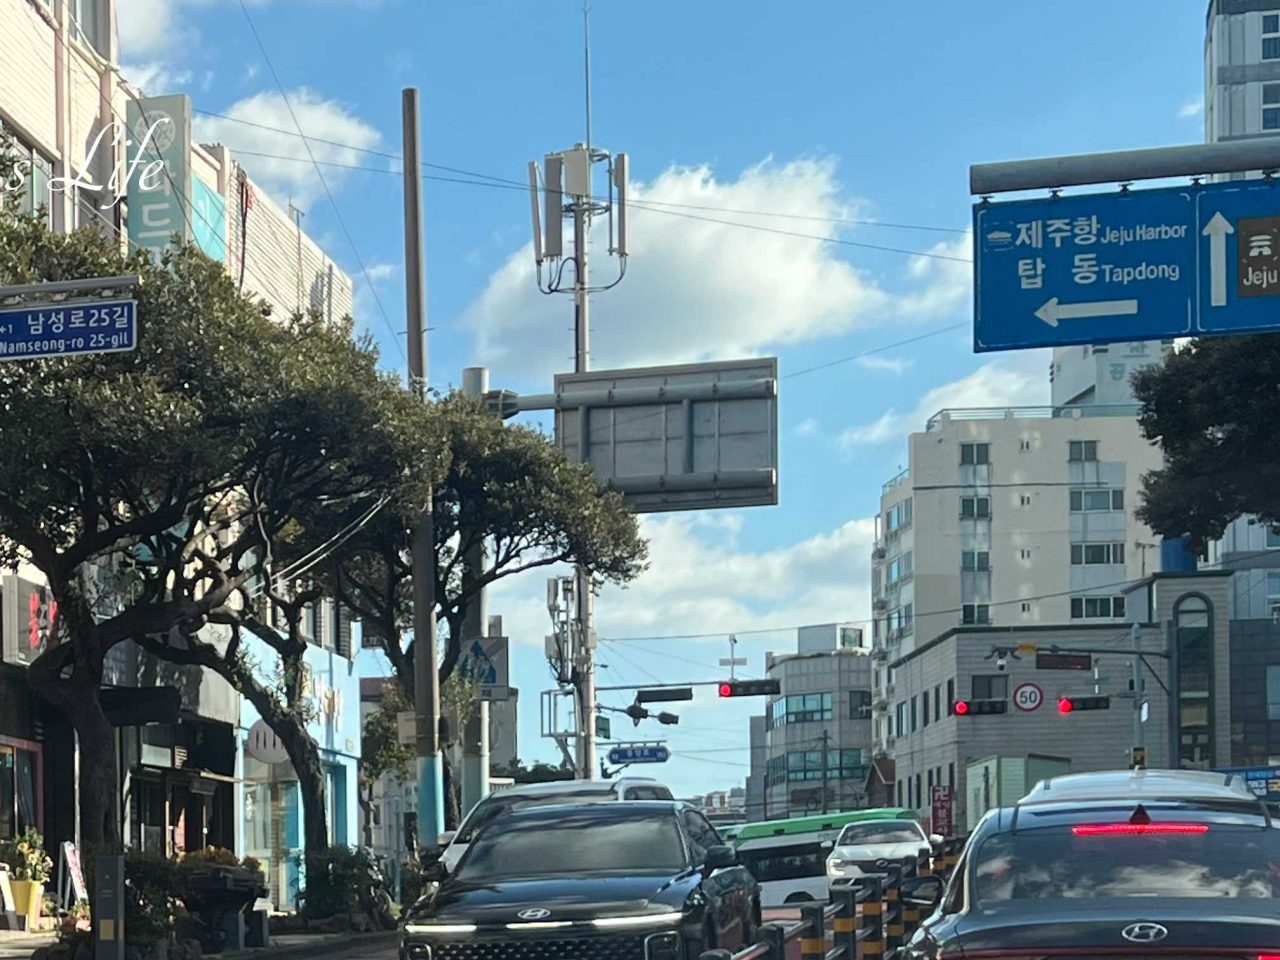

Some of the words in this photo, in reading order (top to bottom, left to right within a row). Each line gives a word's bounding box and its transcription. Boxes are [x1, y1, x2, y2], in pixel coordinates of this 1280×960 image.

[1015, 215, 1101, 248] 제주항
[1101, 226, 1134, 246] Jeju
[1136, 223, 1187, 241] Harbor
[1101, 262, 1180, 285] Tapdong
[1243, 266, 1278, 289] Jeju
[27, 306, 128, 335] 남성로25길
[0, 337, 84, 354] Namseong-ro
[89, 332, 129, 348] 25-gil
[1019, 692, 1038, 704] 50
